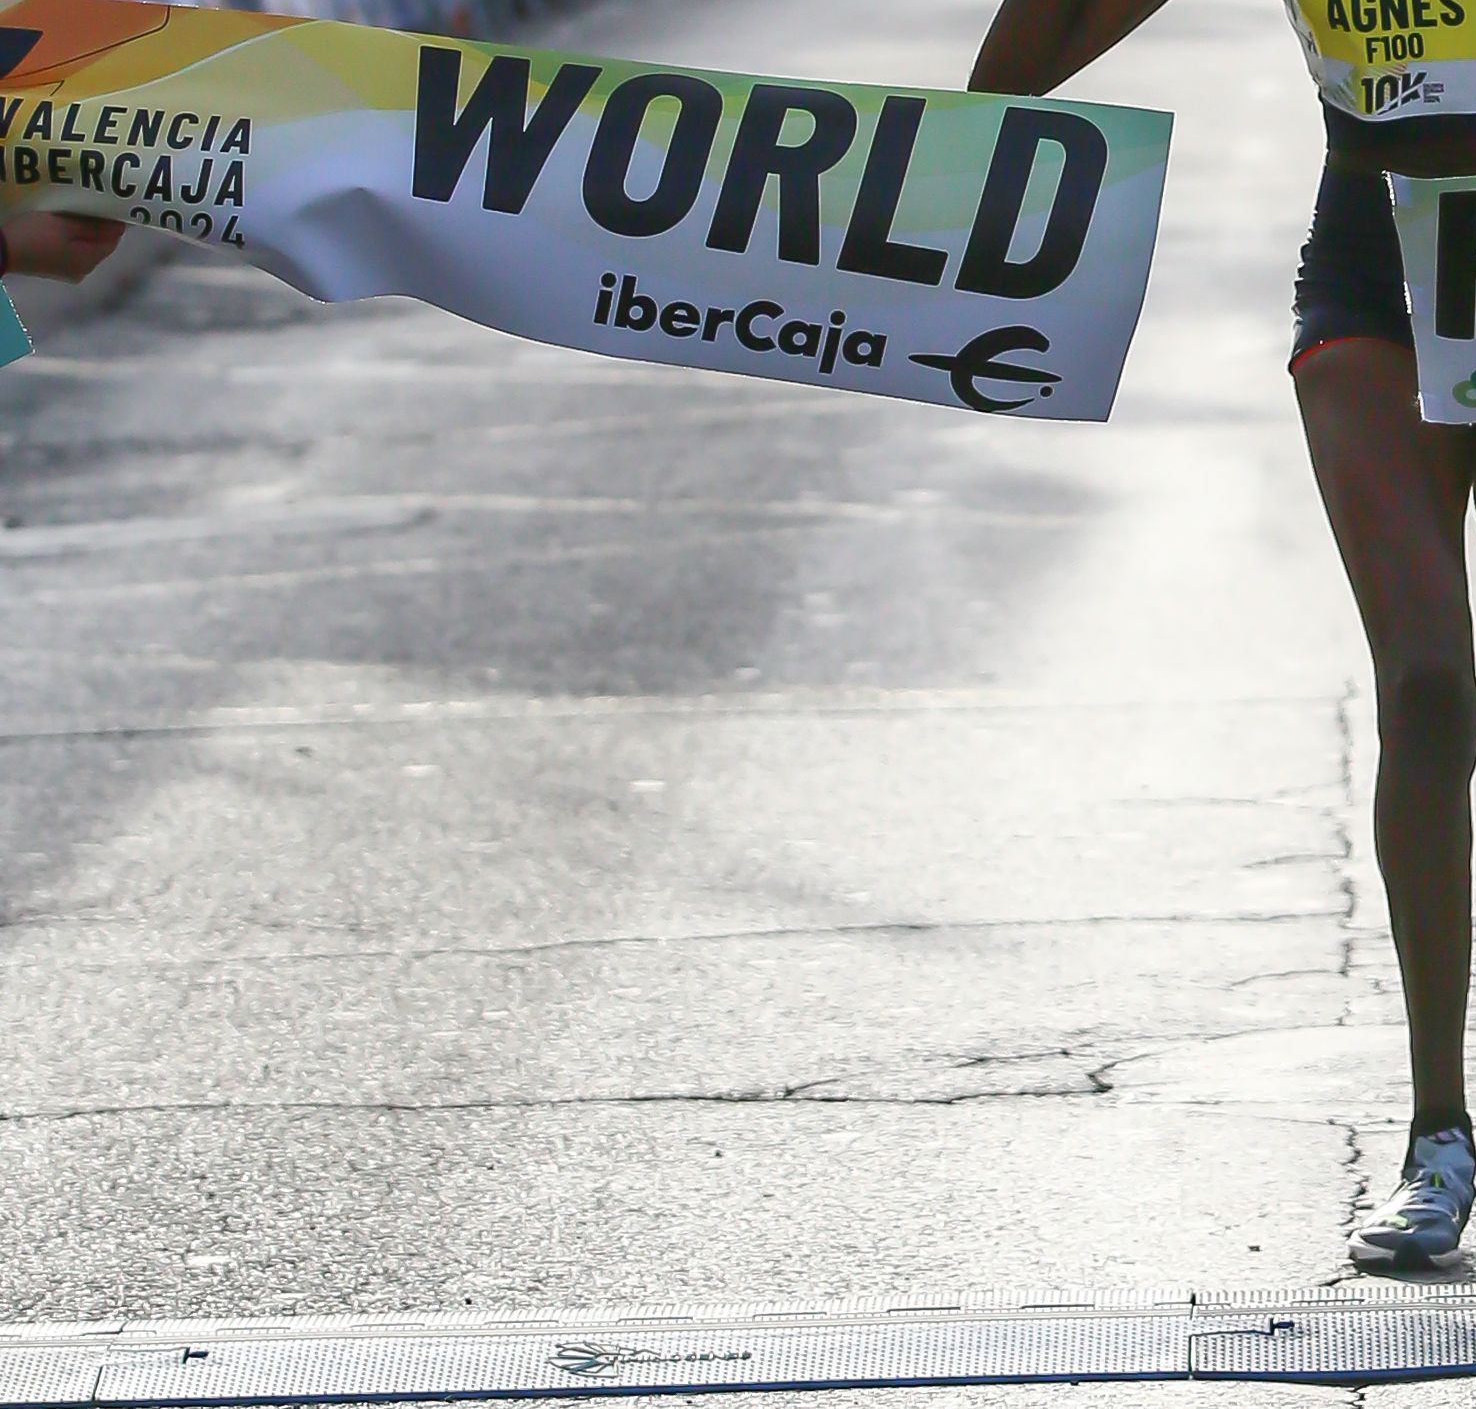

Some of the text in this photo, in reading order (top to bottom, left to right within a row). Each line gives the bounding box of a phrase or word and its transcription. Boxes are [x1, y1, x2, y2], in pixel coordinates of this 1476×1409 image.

[1365, 32, 1424, 63] F100
[1361, 72, 1428, 115] 10K
[0, 97, 251, 154] VALENCIA
[411, 44, 1108, 300] WORLD
[593, 272, 887, 375] iberCaja
